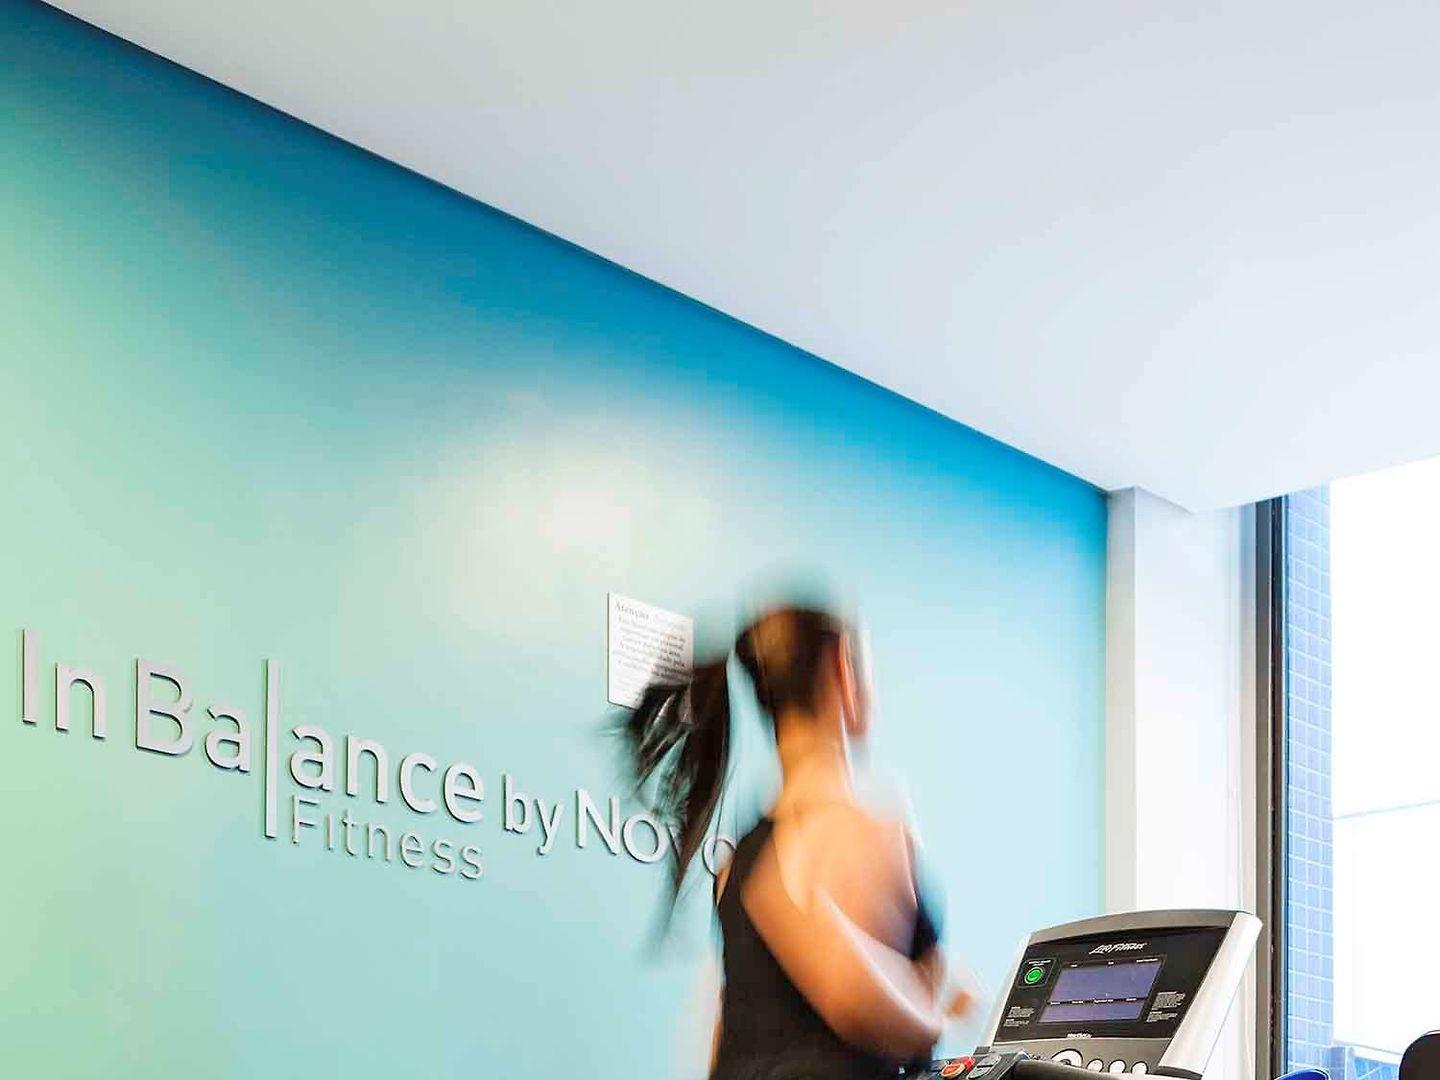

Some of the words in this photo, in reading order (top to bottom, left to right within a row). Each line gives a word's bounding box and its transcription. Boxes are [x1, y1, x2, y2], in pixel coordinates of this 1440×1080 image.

[21, 628, 107, 741] In
[134, 657, 485, 838] Balance
[502, 773, 564, 856] by
[291, 794, 484, 879] Fitness
